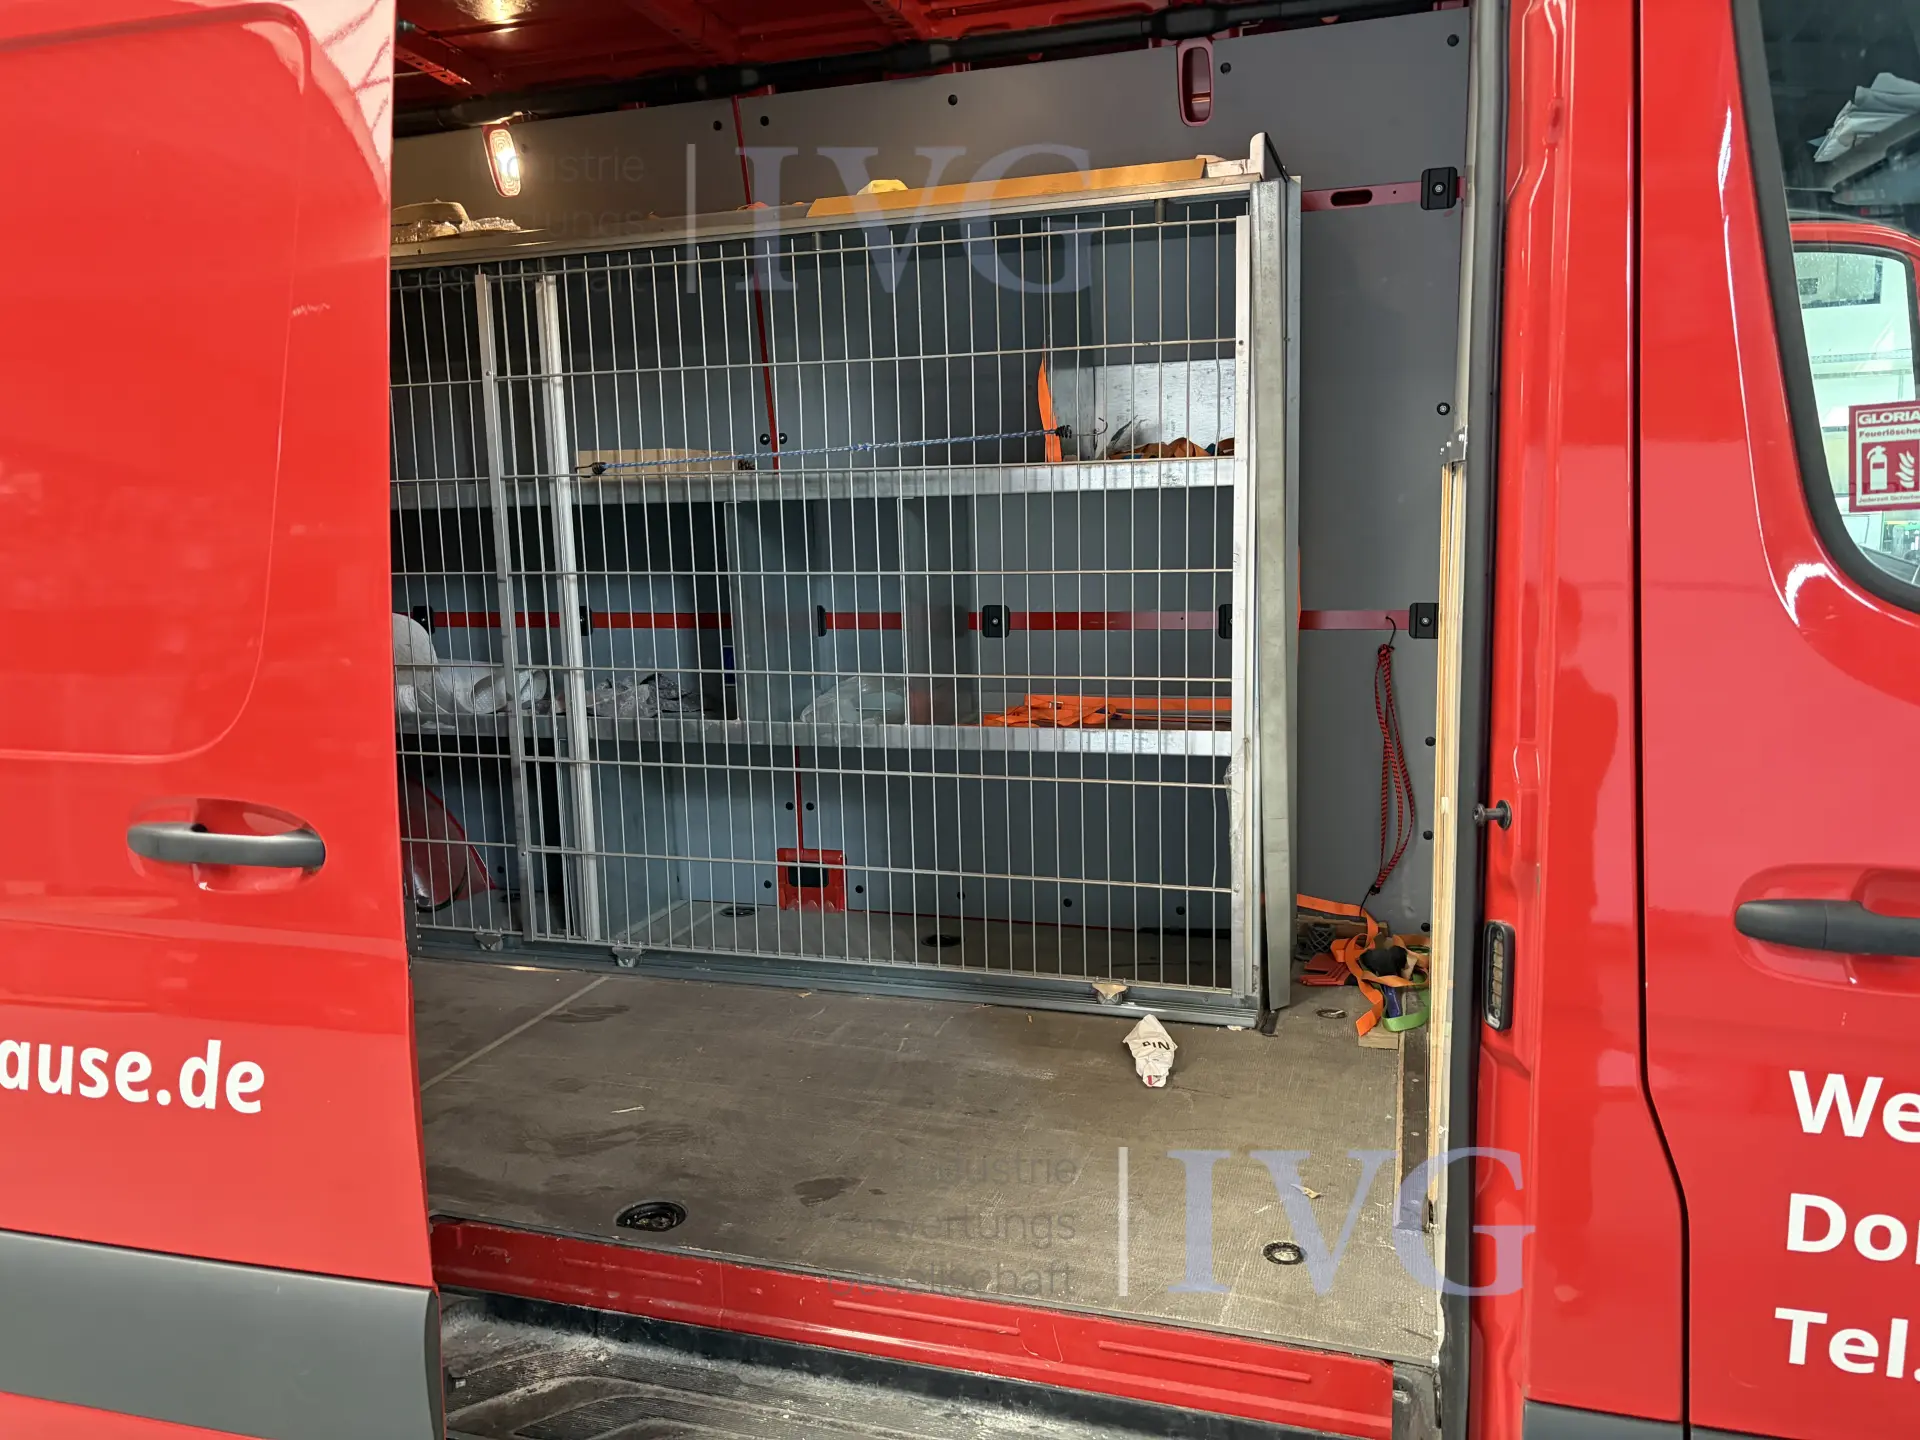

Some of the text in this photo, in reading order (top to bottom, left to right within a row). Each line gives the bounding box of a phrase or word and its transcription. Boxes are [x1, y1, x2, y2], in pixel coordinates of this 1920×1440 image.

[1858, 410, 1920, 425] GLORIA
[0, 1039, 265, 1114] ause.de
[1786, 1192, 1920, 1265] Do
